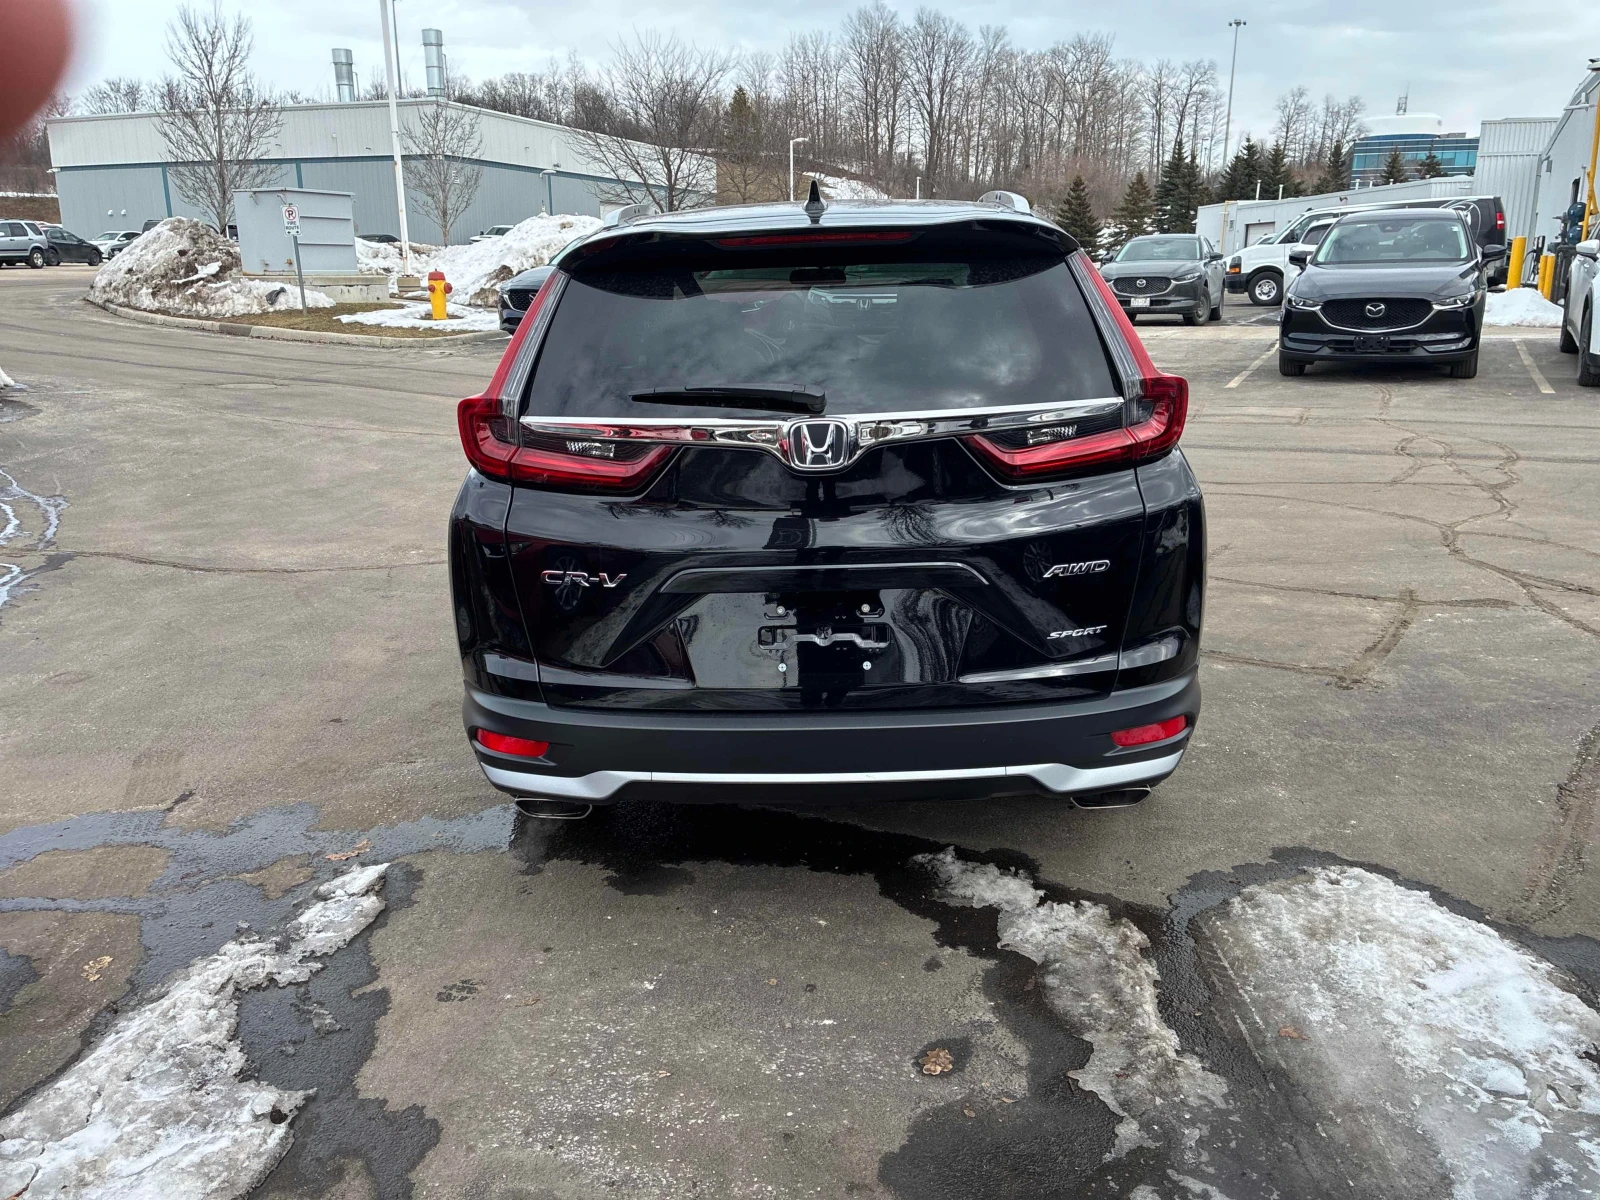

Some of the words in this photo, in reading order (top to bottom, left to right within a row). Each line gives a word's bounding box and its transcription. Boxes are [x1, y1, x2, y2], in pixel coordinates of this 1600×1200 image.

[1042, 559, 1111, 578] AWD
[540, 570, 627, 588] CR-V
[1046, 624, 1108, 639] SPORT
